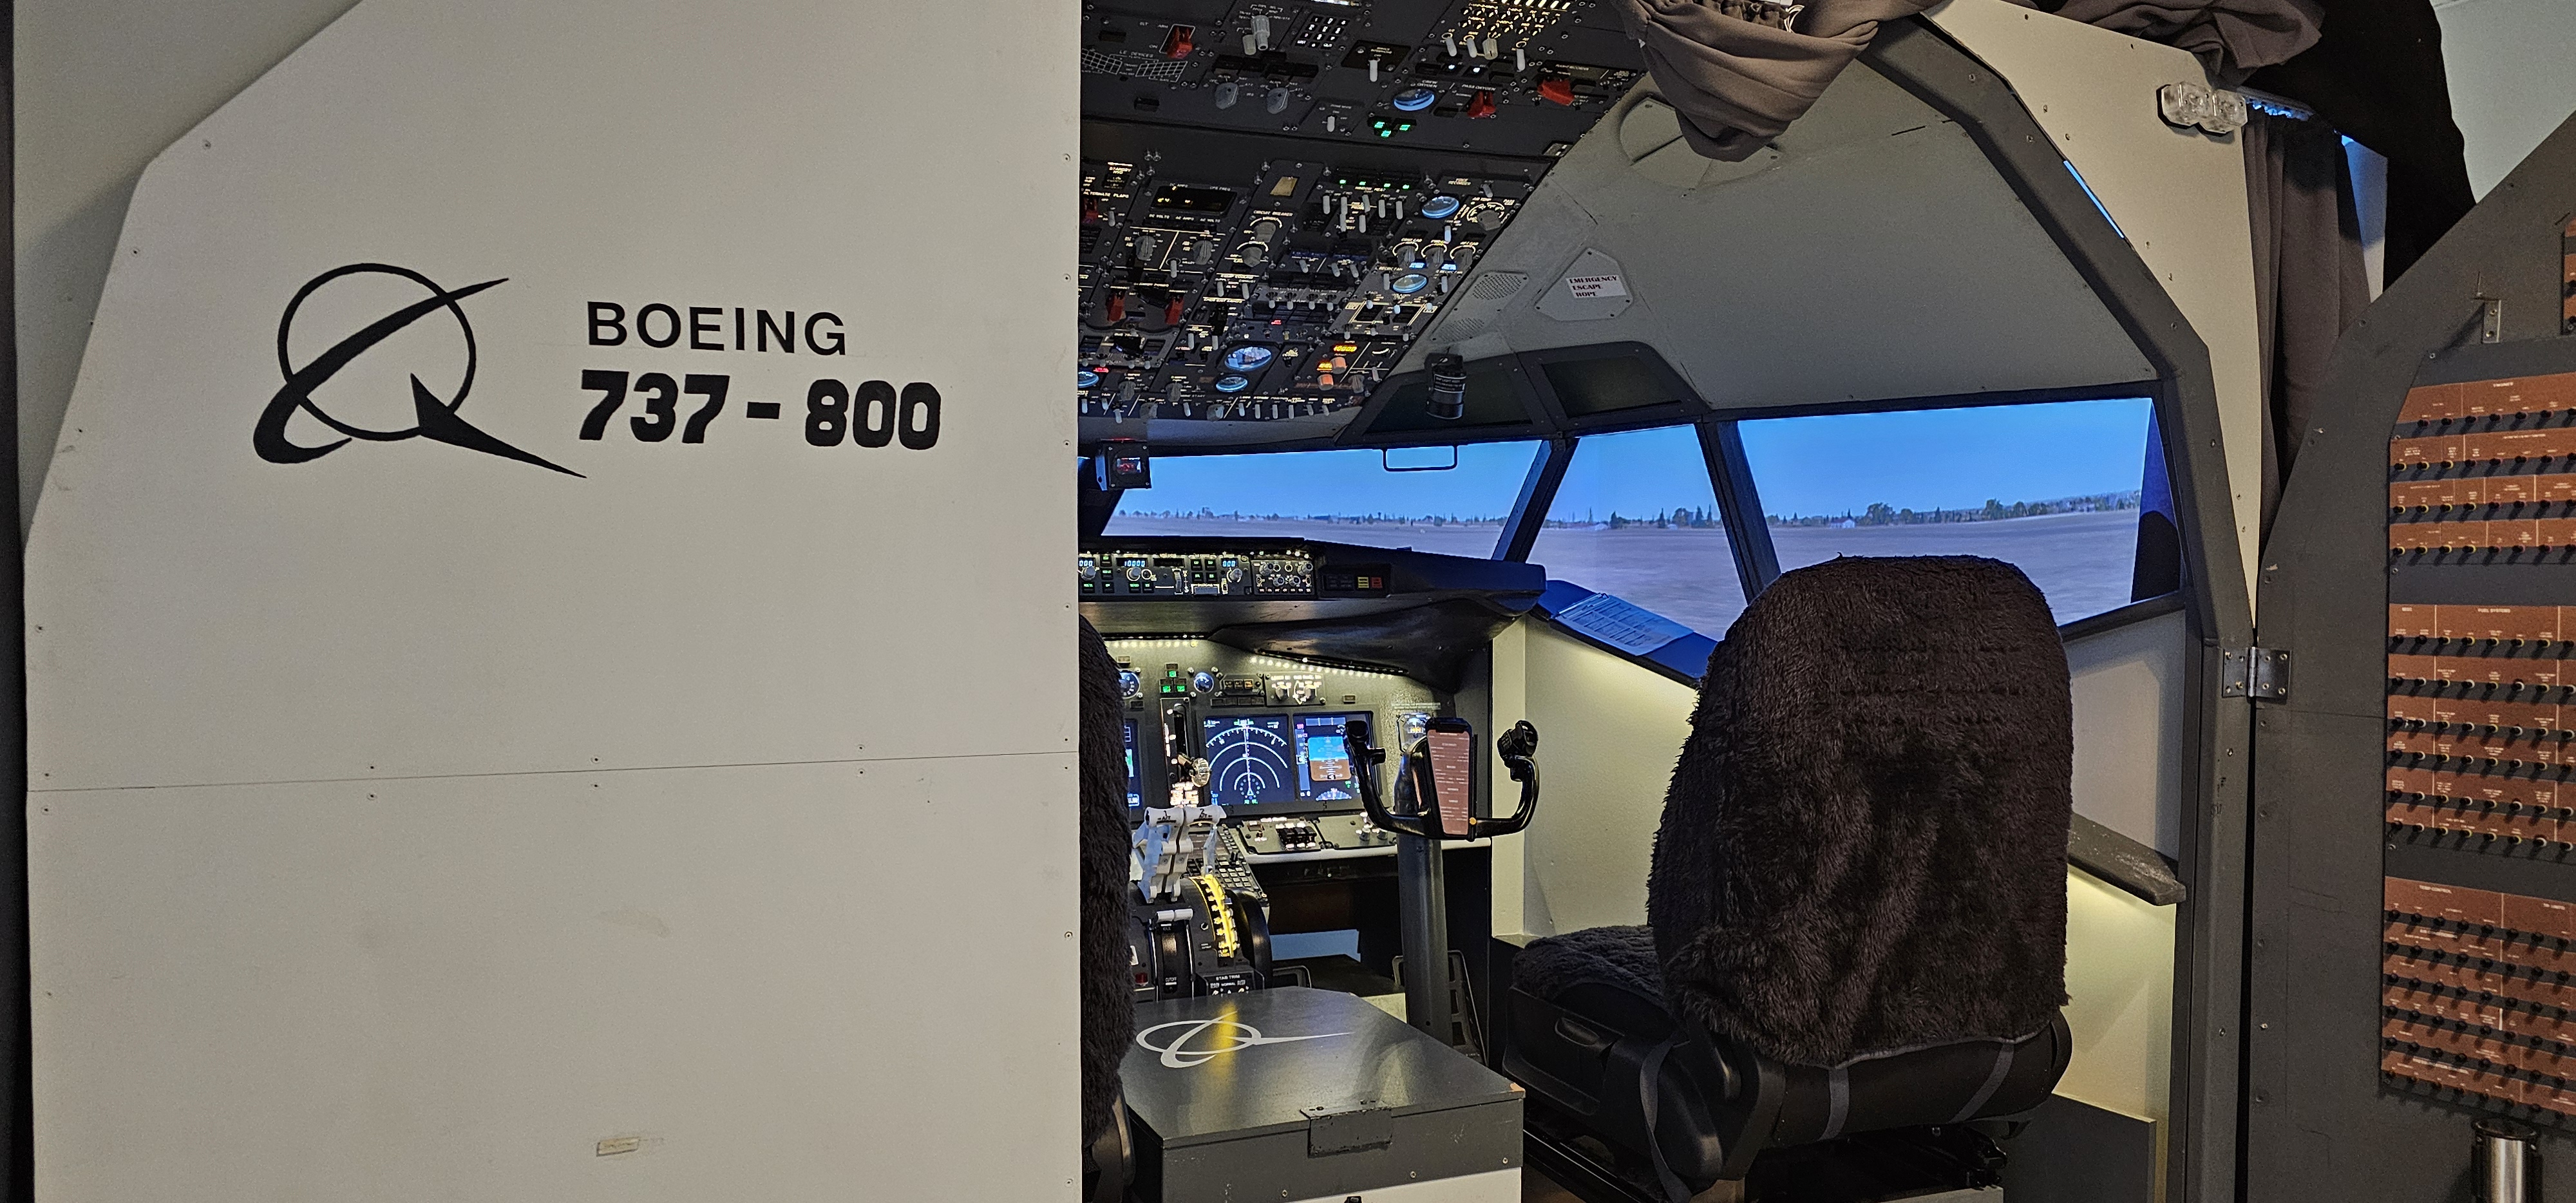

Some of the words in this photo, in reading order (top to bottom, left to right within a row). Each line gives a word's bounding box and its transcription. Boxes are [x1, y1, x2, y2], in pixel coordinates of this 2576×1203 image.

[1569, 276, 1617, 284] EMERGENCY
[587, 301, 846, 356] BOEING
[579, 369, 730, 444] 737
[746, 402, 781, 420] -
[805, 379, 941, 450] 800
[1124, 560, 1146, 568] 10000
